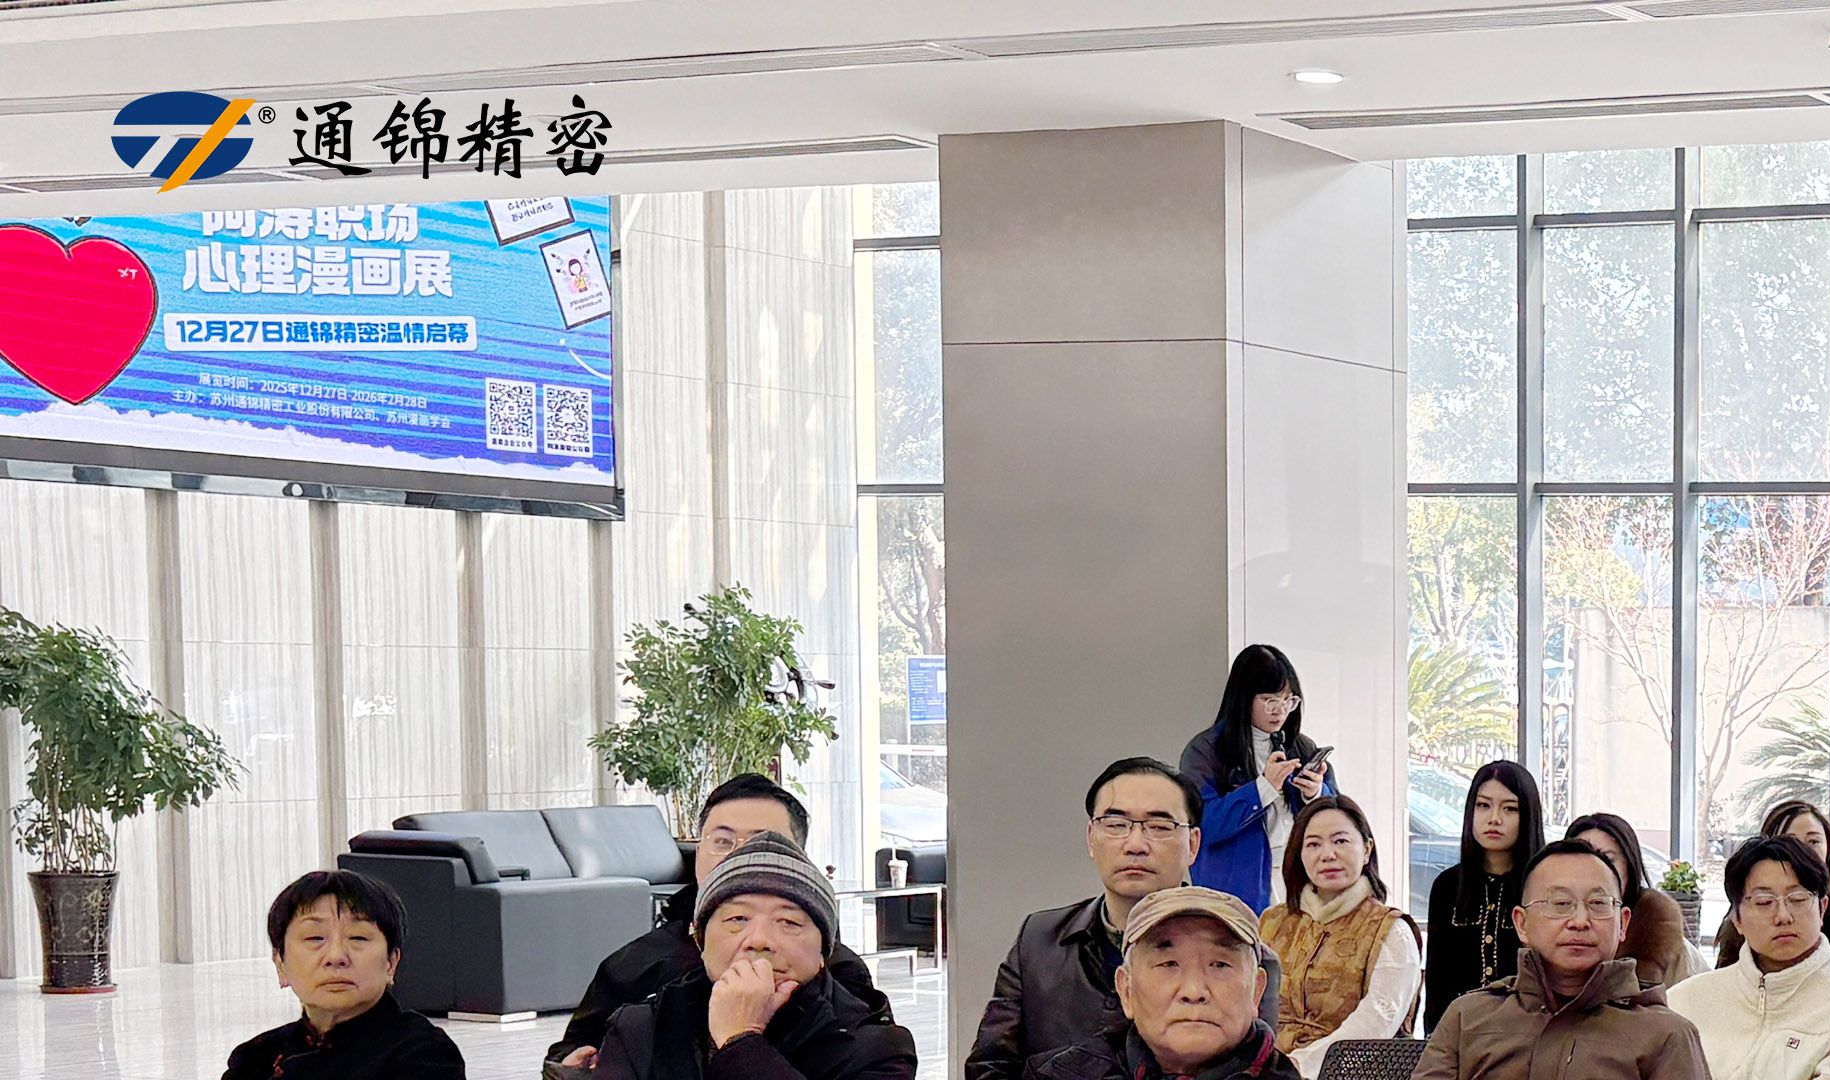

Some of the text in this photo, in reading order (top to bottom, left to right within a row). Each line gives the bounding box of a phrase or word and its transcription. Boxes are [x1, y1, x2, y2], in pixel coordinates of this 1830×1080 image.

[201, 204, 419, 243] 阿涛职场
[182, 241, 453, 297] 心理漫画展
[176, 320, 469, 344] 12月27日通锦精密温情启幕
